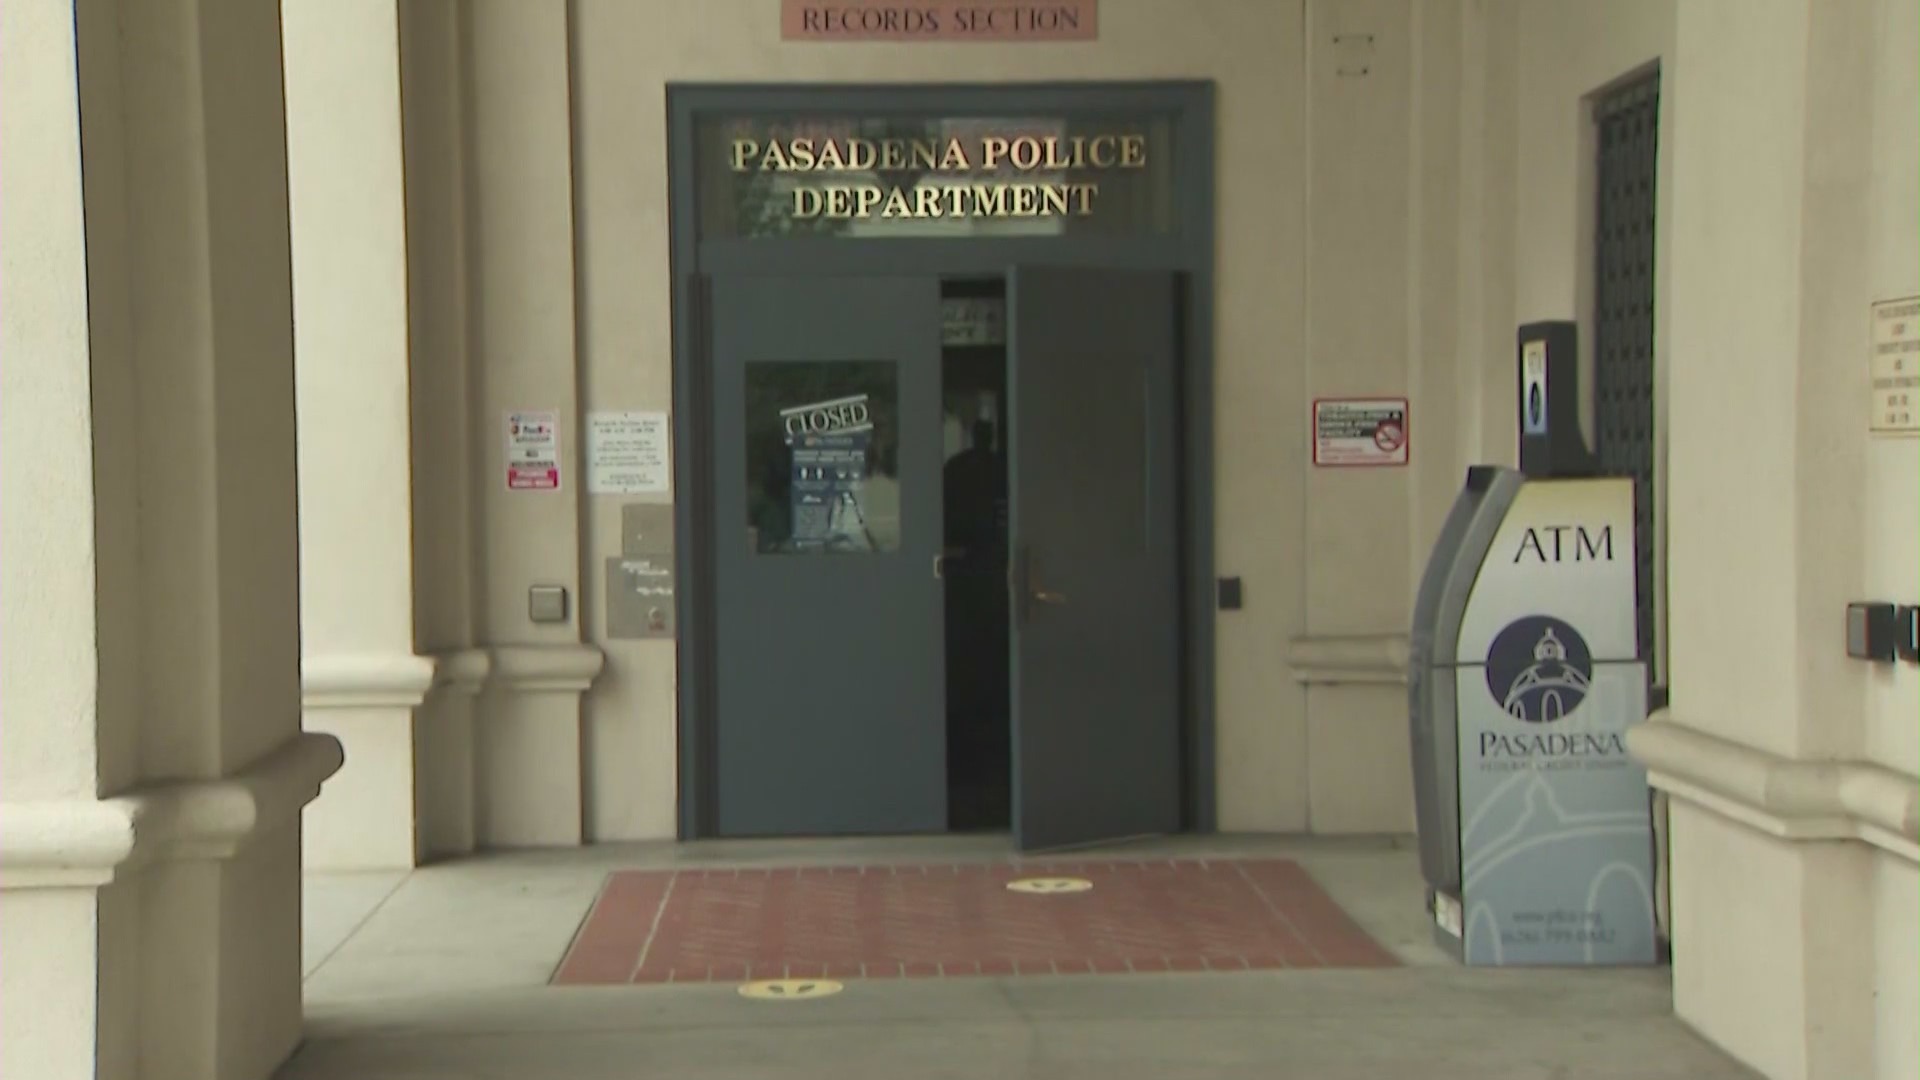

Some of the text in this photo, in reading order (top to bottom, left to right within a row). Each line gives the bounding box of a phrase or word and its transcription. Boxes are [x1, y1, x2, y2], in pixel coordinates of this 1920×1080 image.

[803, 6, 1079, 33] RECORDS SECTION
[730, 134, 1147, 172] PASADENA POLICE
[791, 183, 1099, 219] DEPARTMENT
[785, 402, 868, 436] CLOSED
[1513, 525, 1613, 563] ATM
[1480, 731, 1624, 757] PASADENA
